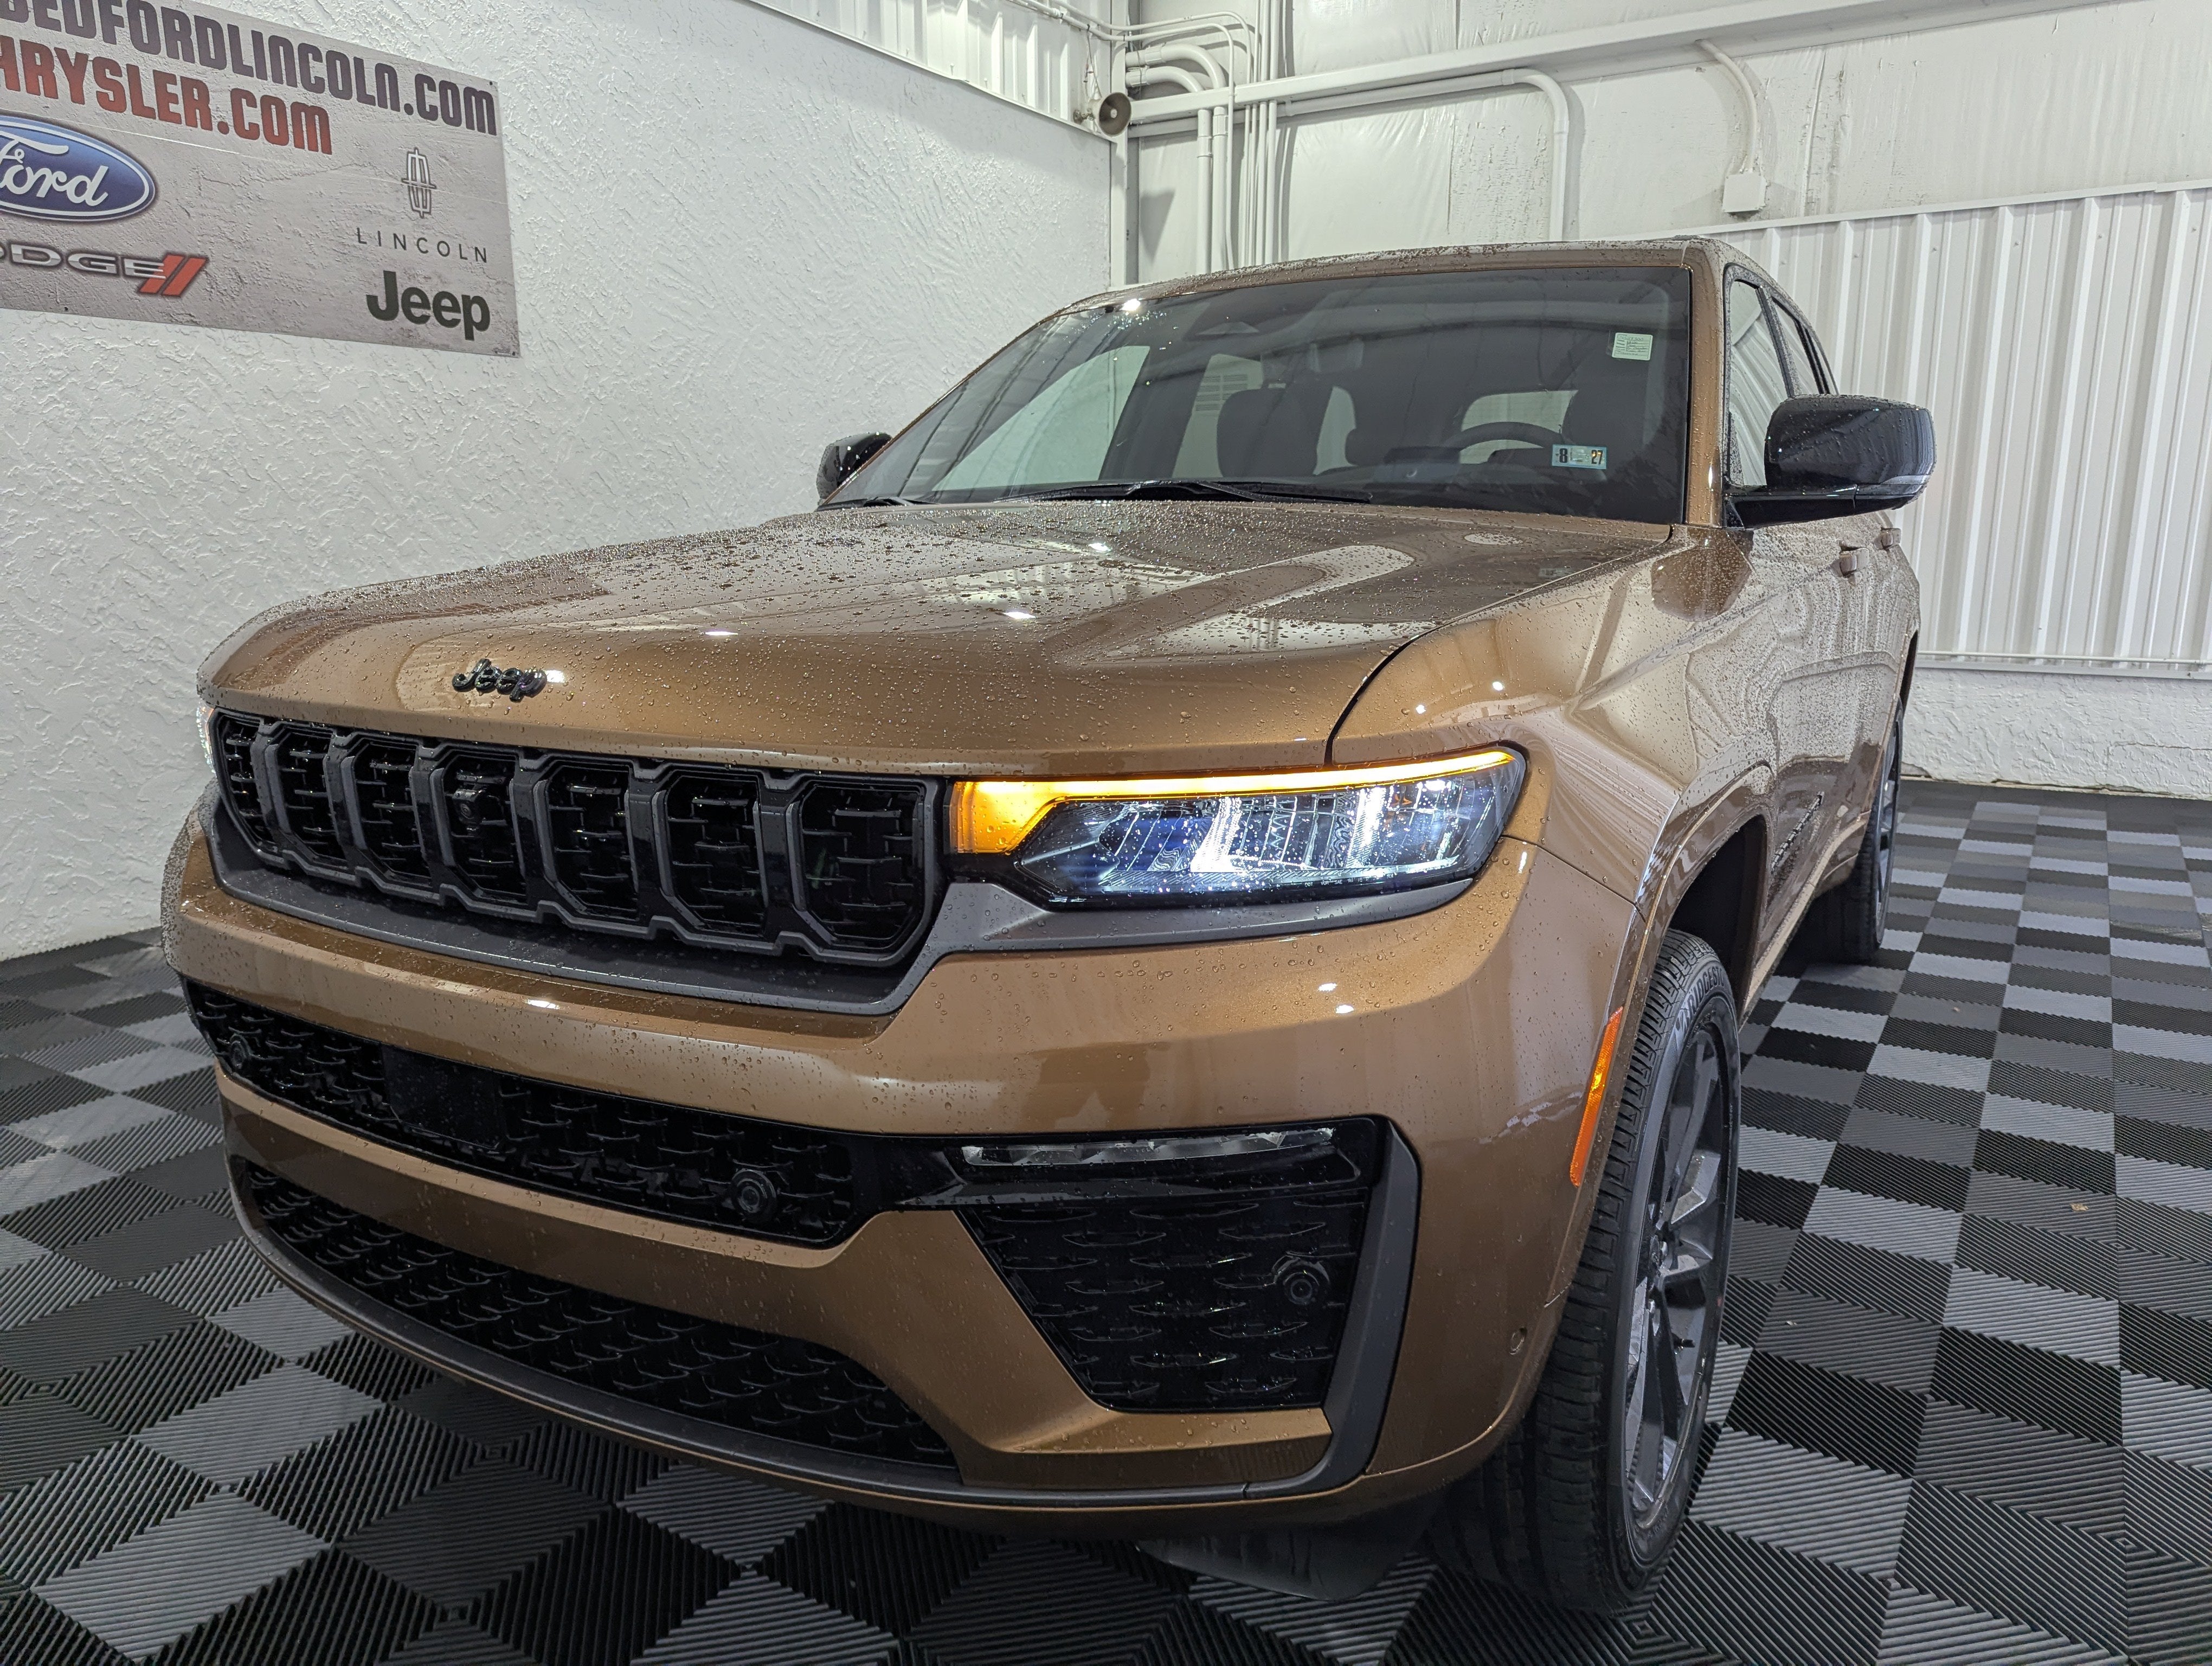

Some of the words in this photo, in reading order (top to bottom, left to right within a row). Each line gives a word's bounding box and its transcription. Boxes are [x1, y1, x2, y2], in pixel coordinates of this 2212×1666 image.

[0, 244, 166, 280] DGE
[356, 227, 487, 263] LINCOLN
[365, 270, 491, 341] Jeep
[1559, 448, 1568, 464] 8
[1591, 449, 1603, 465] 27
[452, 658, 548, 703] Jeep
